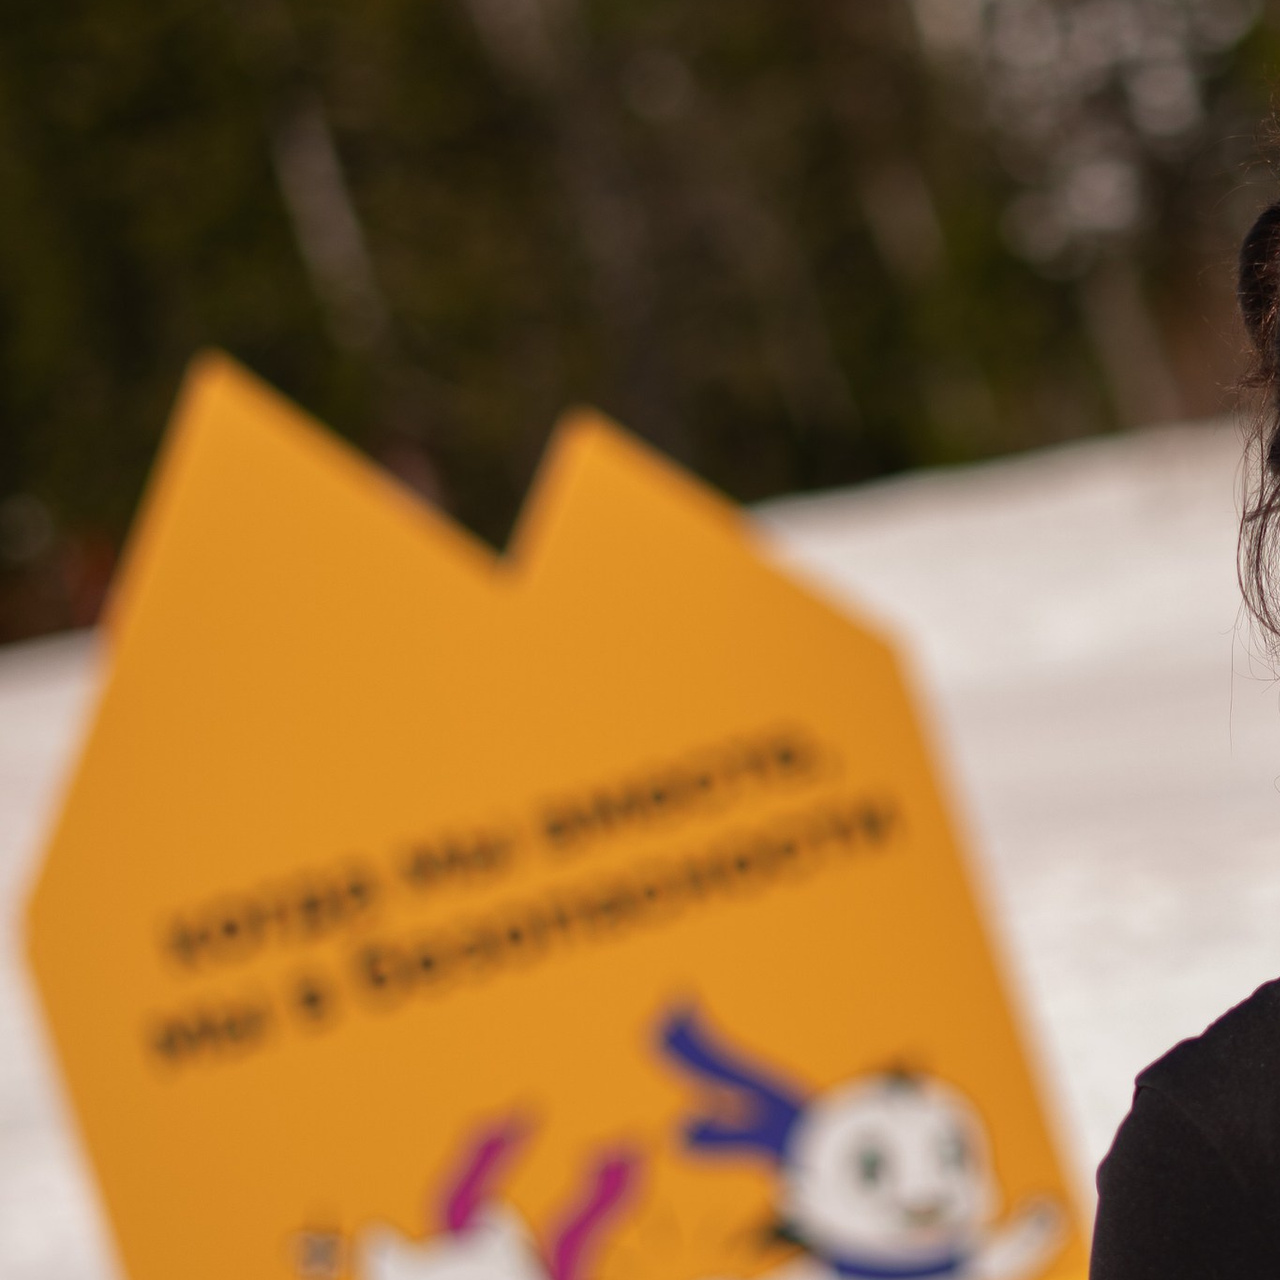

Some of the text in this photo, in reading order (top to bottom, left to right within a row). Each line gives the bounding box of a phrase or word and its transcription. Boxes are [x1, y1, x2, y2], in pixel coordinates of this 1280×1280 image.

[142, 786, 906, 1074] мы в безопасности
[153, 851, 388, 974] когда
[394, 814, 524, 902] мы
